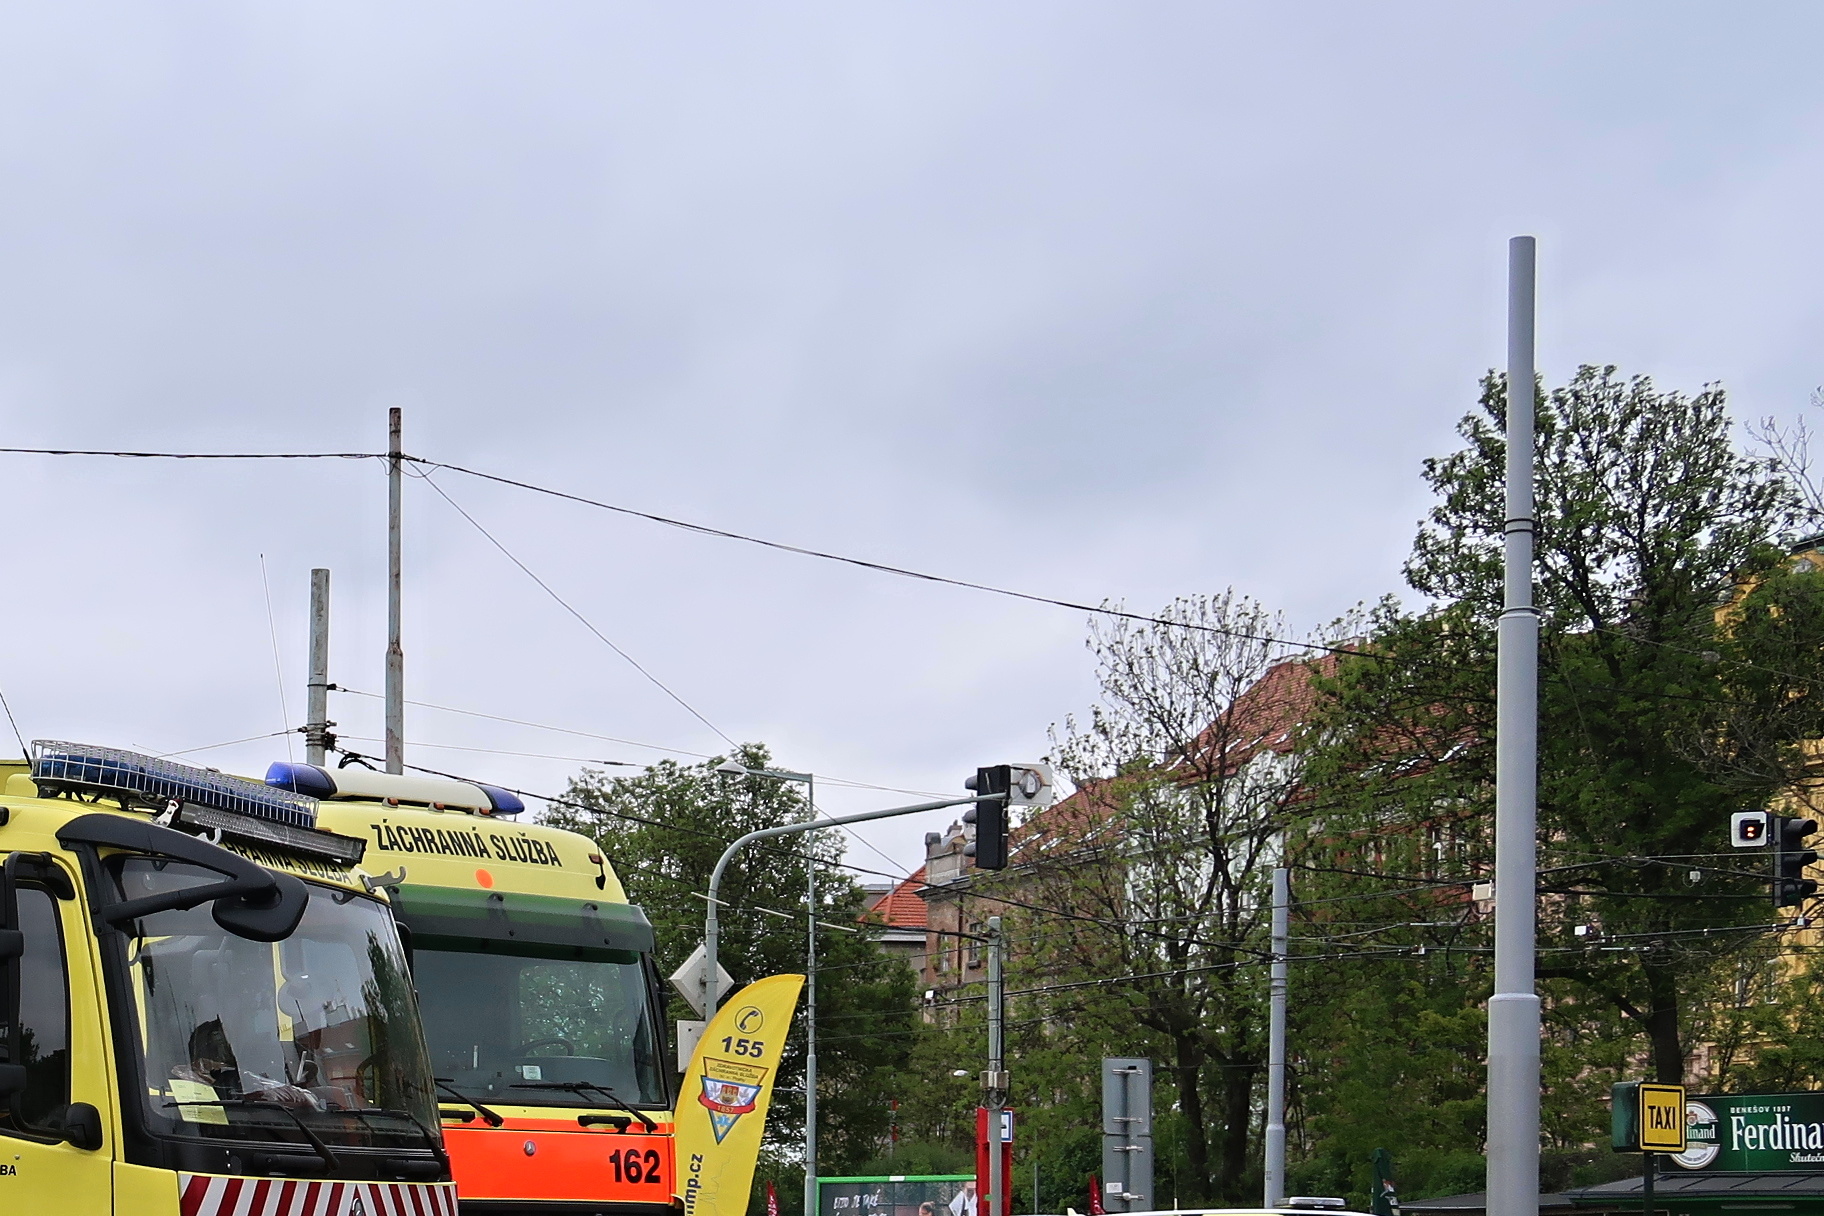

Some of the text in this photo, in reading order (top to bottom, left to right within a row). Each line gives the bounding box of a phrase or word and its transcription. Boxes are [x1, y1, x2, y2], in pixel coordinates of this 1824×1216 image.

[370, 818, 562, 867] ZÁCHRANNÁ SLUŽBA
[722, 1036, 764, 1058] 155
[1647, 1105, 1676, 1130] TAXI
[1730, 1113, 1824, 1151] Ferdina
[609, 1149, 661, 1184] 162
